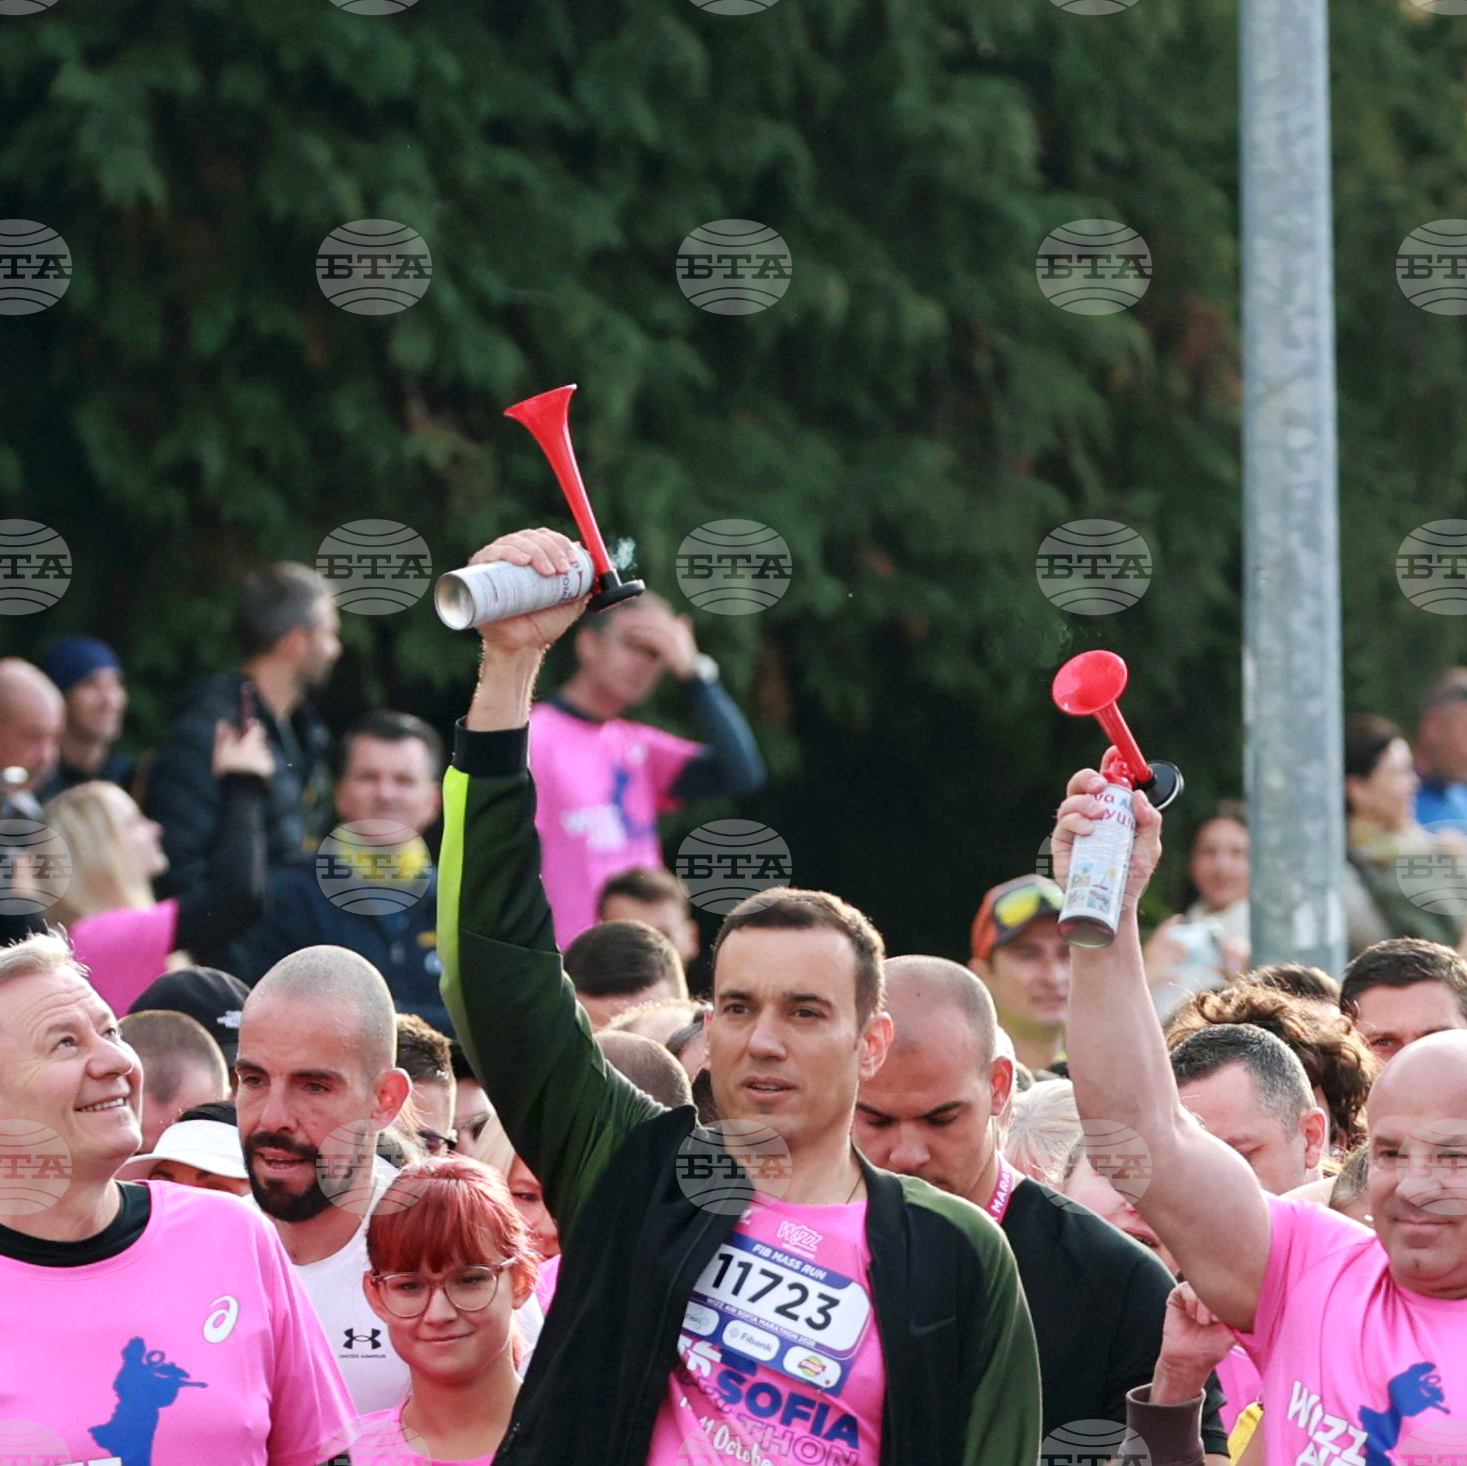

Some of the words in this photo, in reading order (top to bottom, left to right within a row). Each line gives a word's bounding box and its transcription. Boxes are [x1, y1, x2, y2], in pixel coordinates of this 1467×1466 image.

[751, 1243, 770, 1258] FIB
[771, 1250, 804, 1270] MASS
[799, 1263, 827, 1281] RUN
[712, 1253, 840, 1331] 11723
[739, 1331, 773, 1352] Fibank
[716, 1369, 860, 1450] SOFIA
